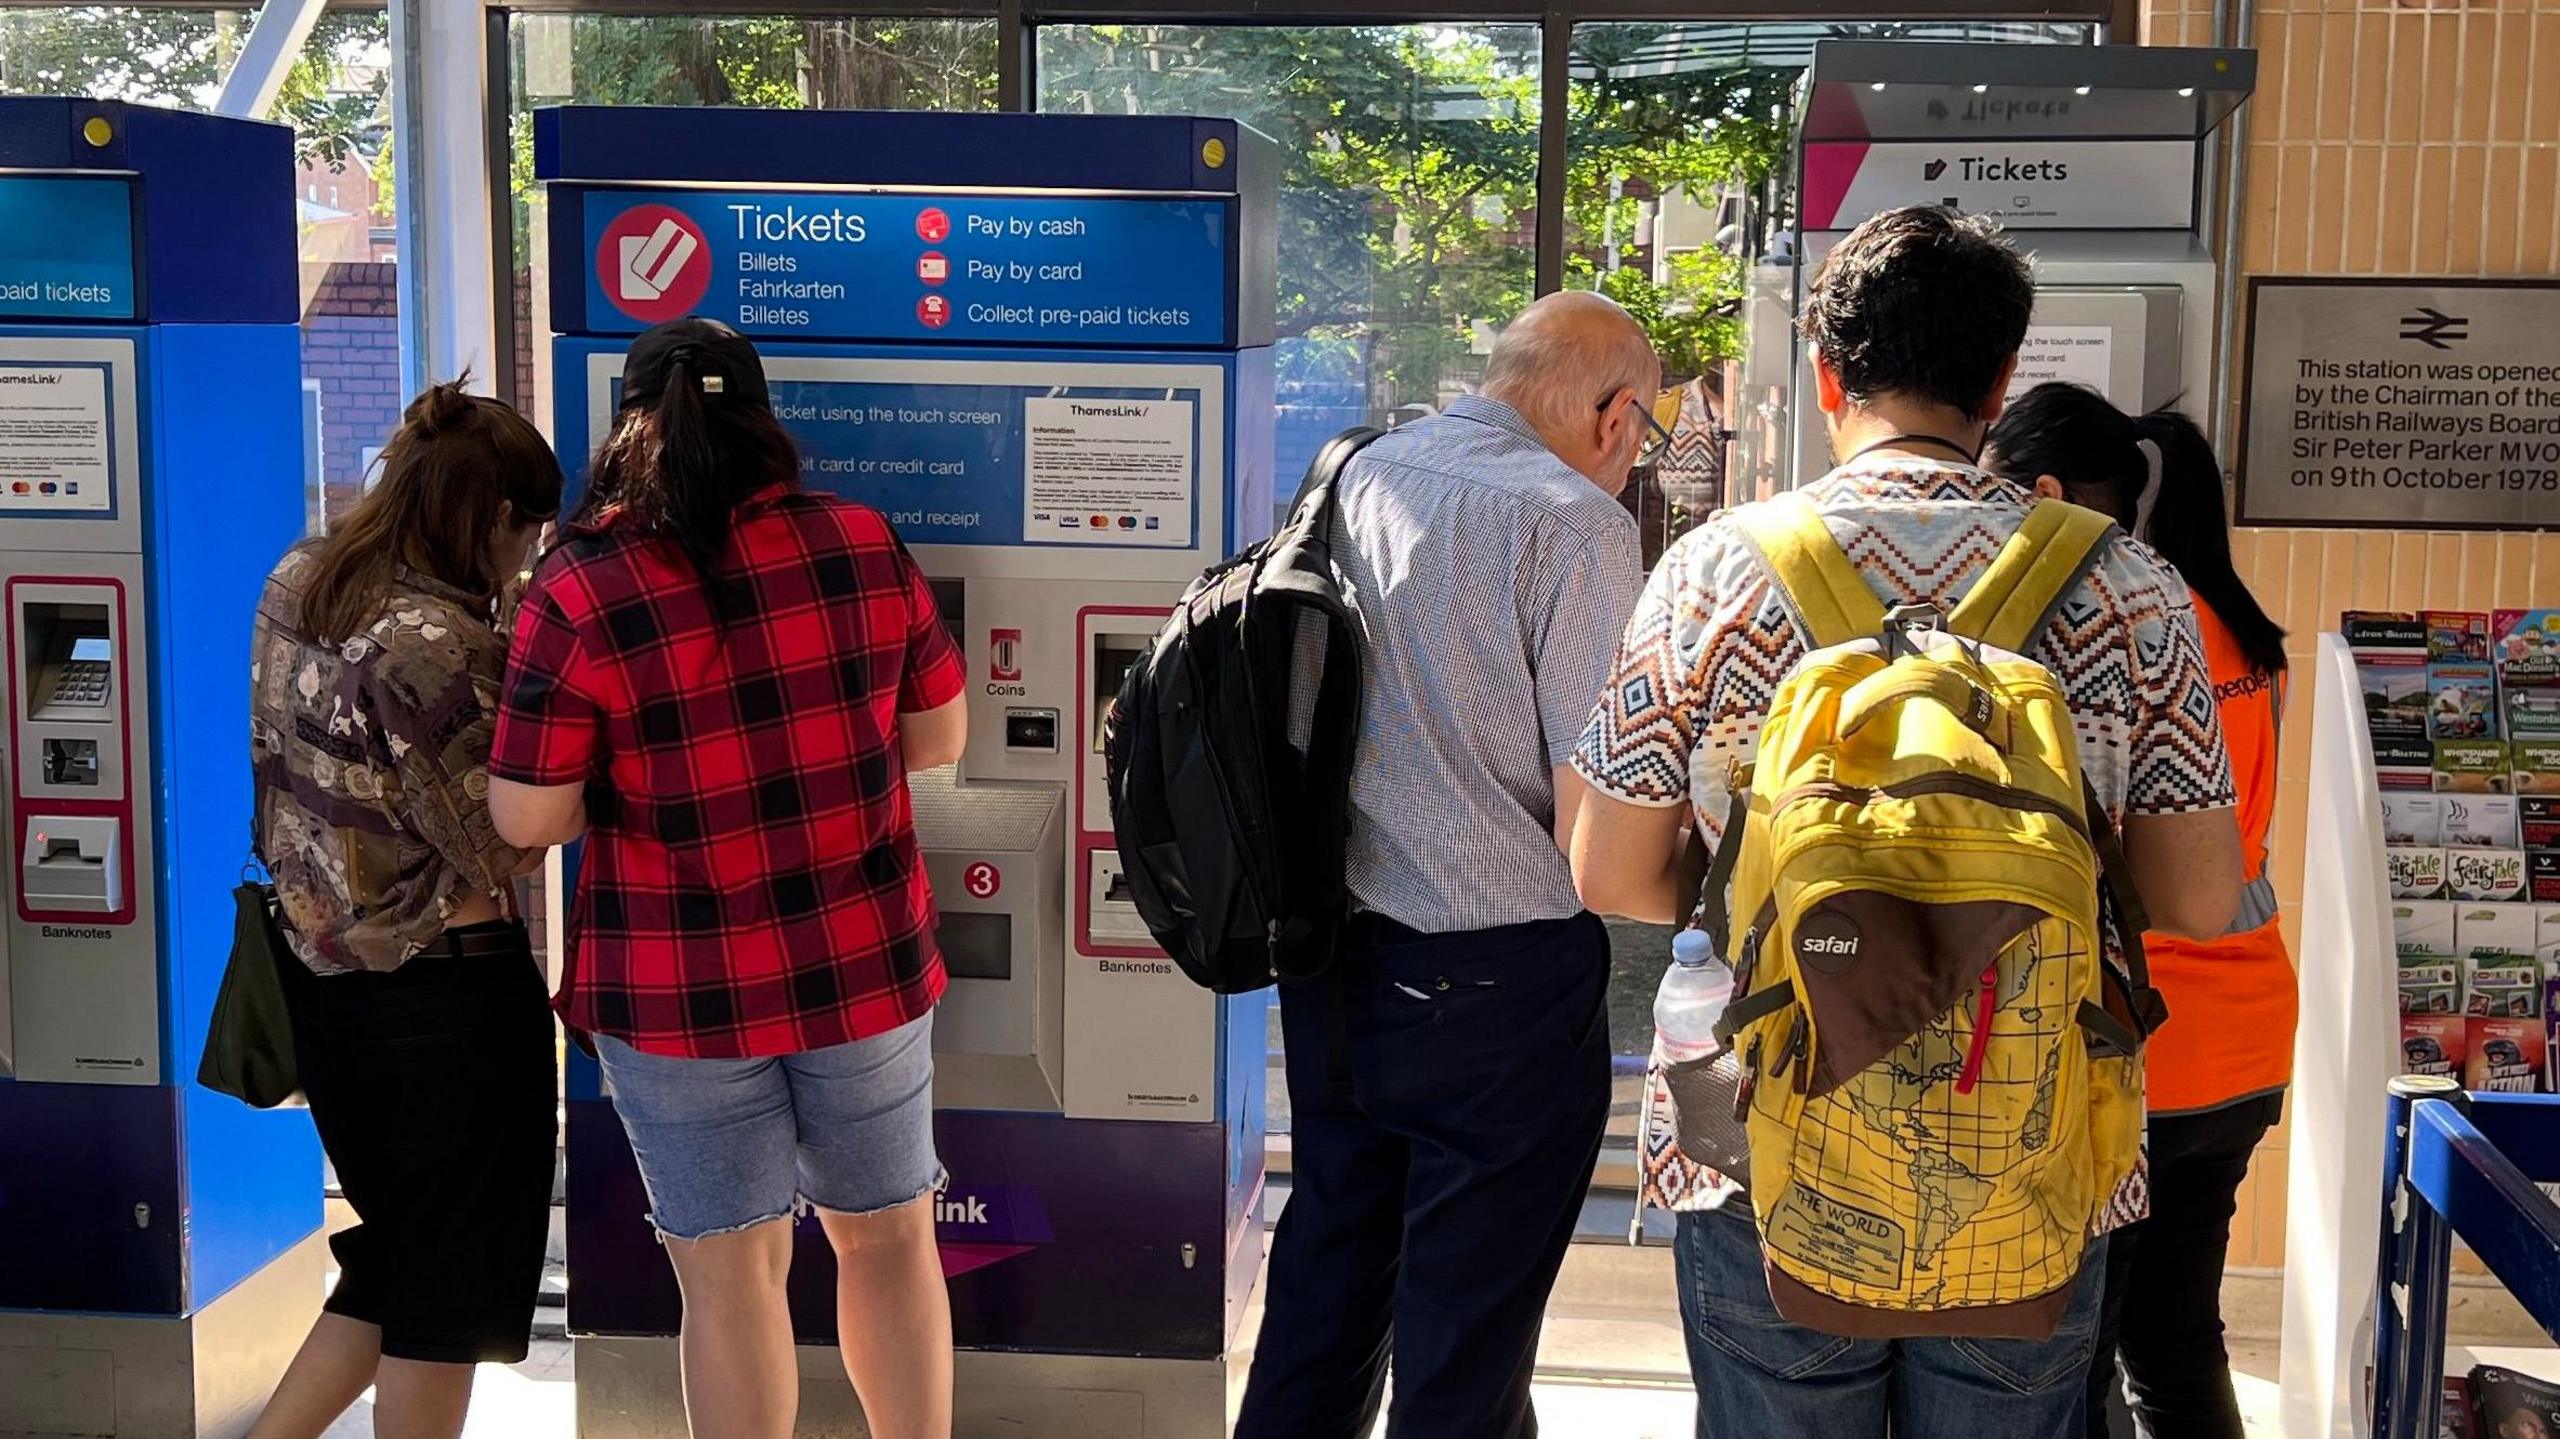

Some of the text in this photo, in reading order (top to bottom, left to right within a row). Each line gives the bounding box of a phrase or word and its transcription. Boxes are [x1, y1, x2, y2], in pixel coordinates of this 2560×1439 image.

[1959, 157, 2068, 181] Tickets
[727, 204, 867, 243] Tickets
[968, 215, 1086, 239] Pay by cash
[739, 252, 797, 273] Billets
[968, 260, 1082, 284] Pay by card
[45, 283, 111, 302] tickets
[740, 279, 845, 299] Fahrkarten
[740, 305, 810, 325] Billetes
[968, 303, 1190, 328] Collect pre-paid tickets
[2027, 371, 2056, 379] receipt
[2298, 360, 2340, 378] This
[2345, 361, 2421, 379] station
[2427, 365, 2473, 380] was
[2295, 385, 2560, 408] by the Chairman of the
[774, 405, 1001, 425] ticket using the touch screen
[2294, 412, 2560, 436] British Railways Board
[2293, 438, 2560, 462] Sir Peter Parker MVO
[819, 457, 855, 472] card
[859, 461, 874, 473] or
[880, 460, 924, 473] credit
[929, 460, 965, 475] card
[2291, 466, 2557, 490] on 9th October 1978
[892, 509, 980, 528] and receipt
[986, 683, 1026, 697] Coins
[2461, 757, 2482, 765] ZOO
[972, 866, 993, 895] 3
[42, 926, 112, 941] Banknotes
[1802, 936, 1859, 955] safari
[1099, 960, 1172, 975] Banknotes
[1794, 1186, 1890, 1238] THE WORLD
